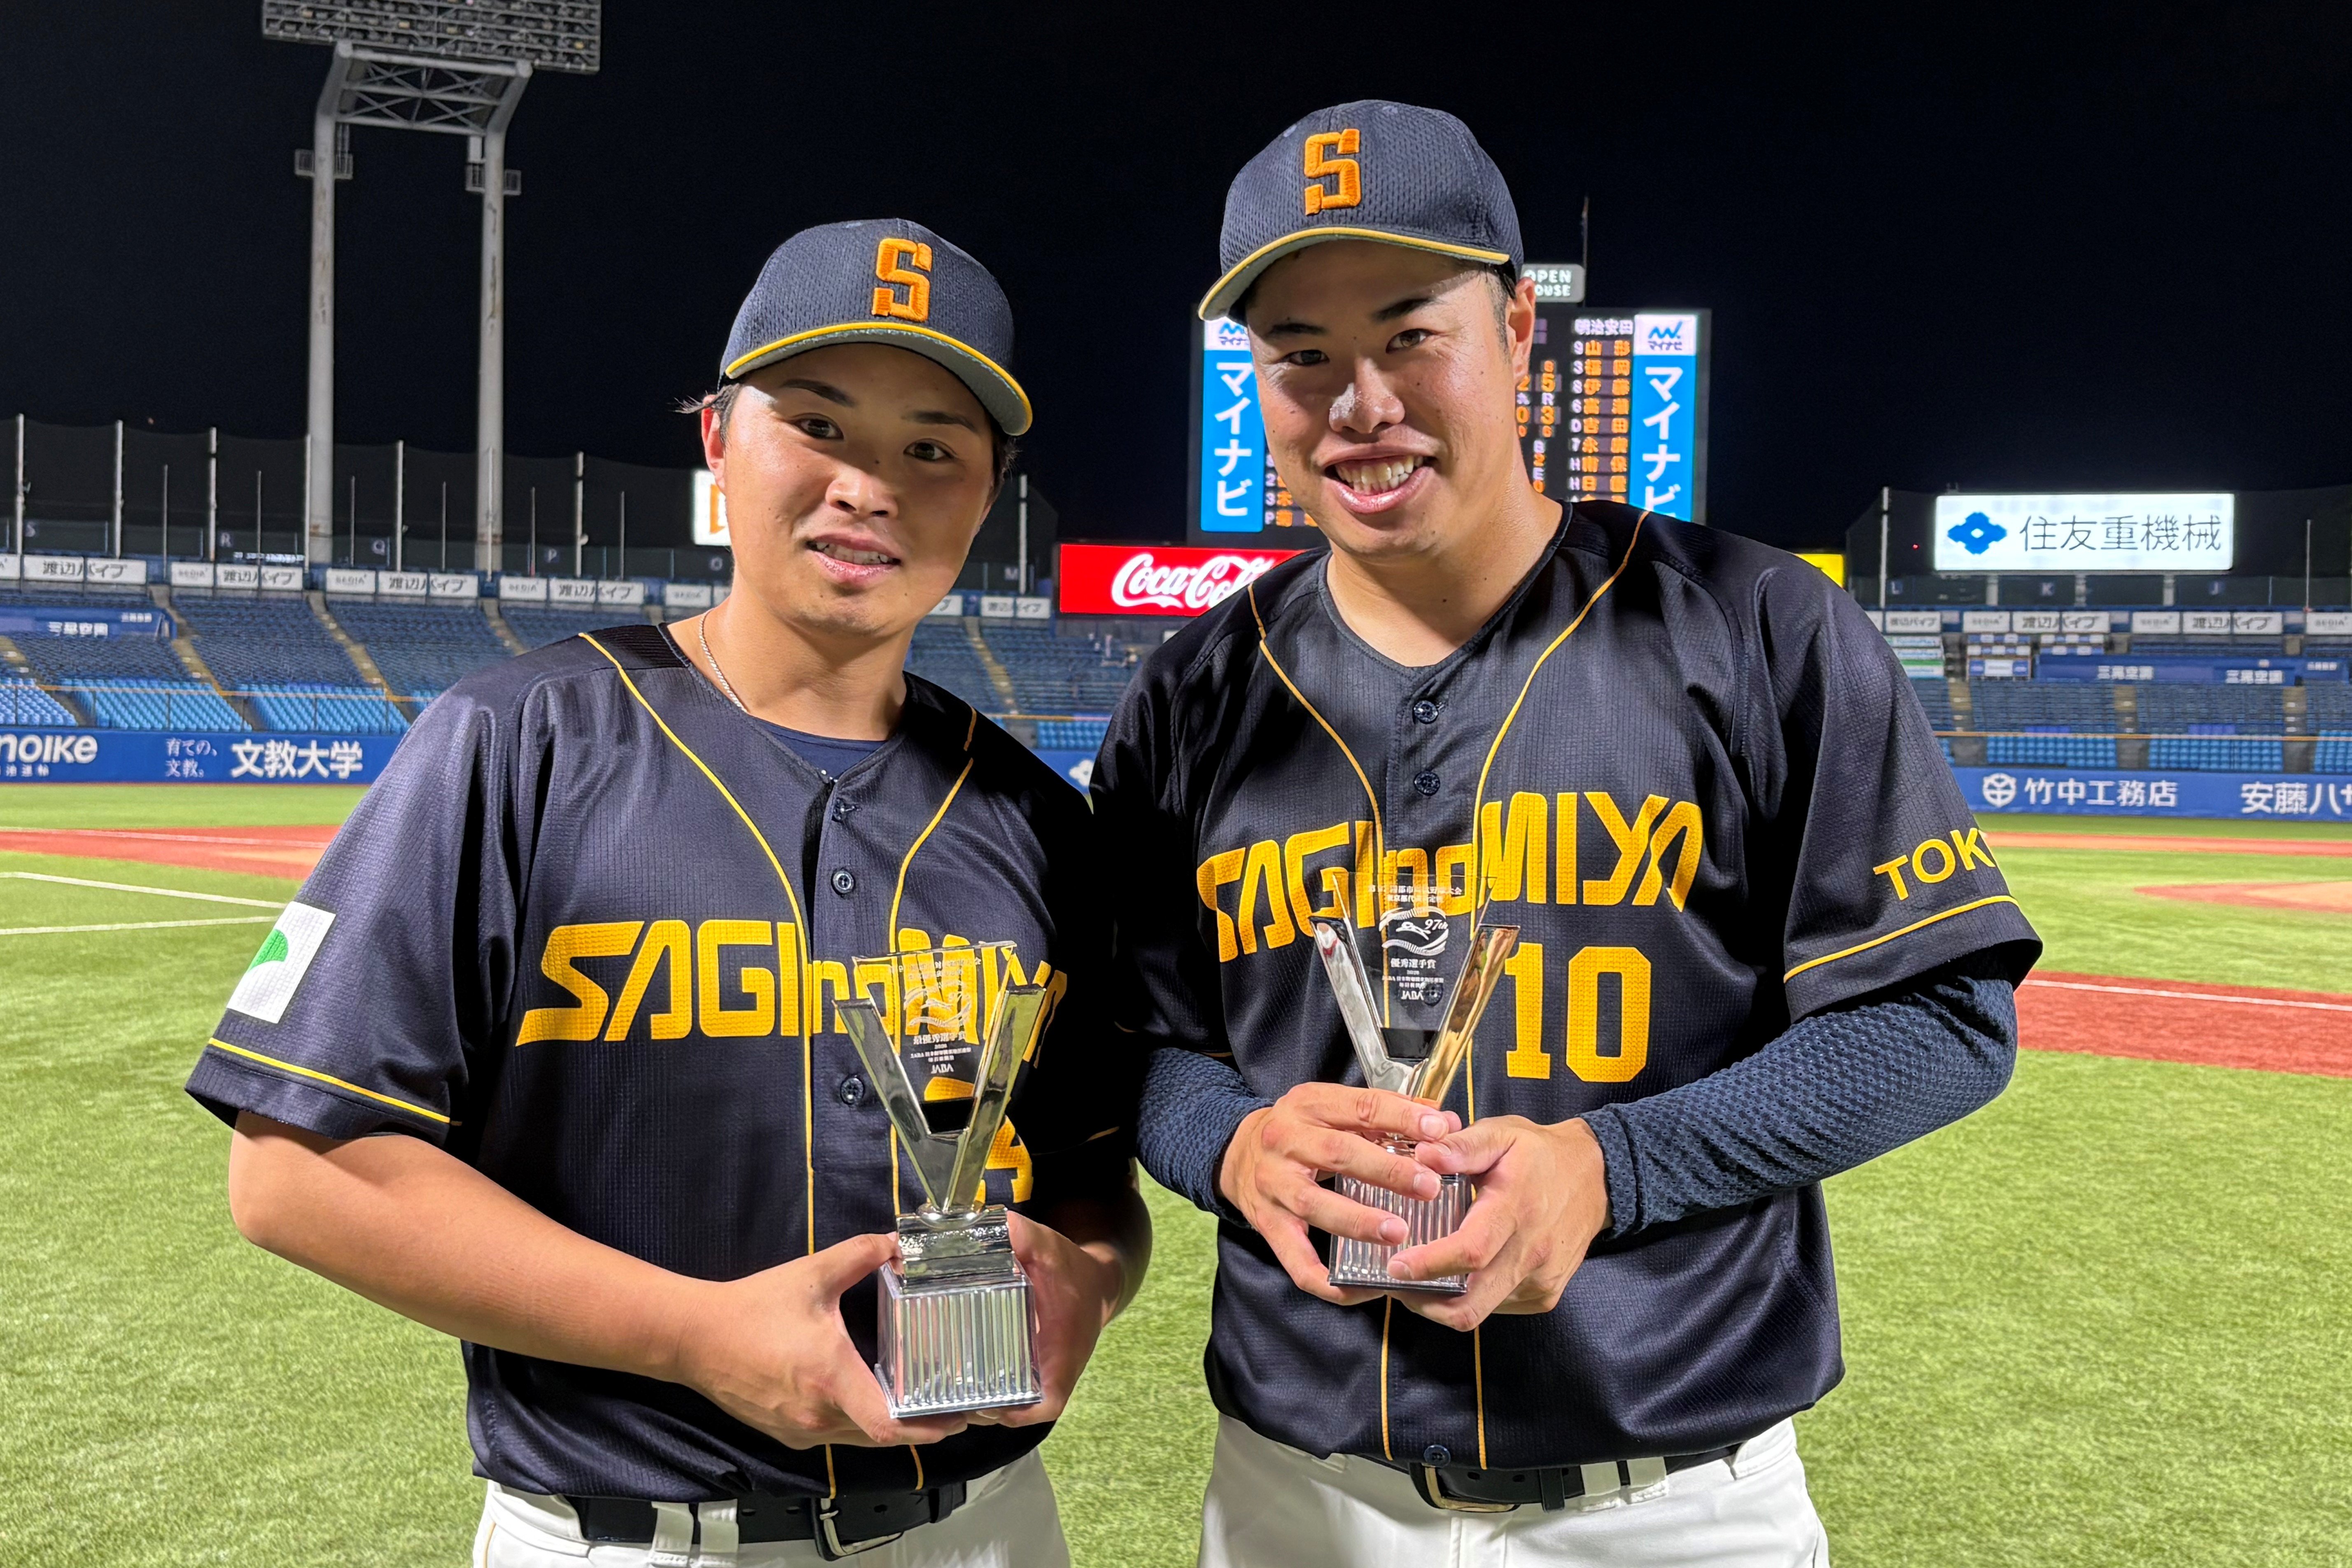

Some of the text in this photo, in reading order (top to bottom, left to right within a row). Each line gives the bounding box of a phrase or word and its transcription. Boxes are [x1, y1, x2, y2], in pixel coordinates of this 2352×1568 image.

[1304, 128, 1361, 215] S
[871, 238, 932, 323] S
[1524, 270, 1571, 283] OPEN
[1534, 284, 1570, 296] OUSE
[1574, 318, 1633, 336] 明治安田
[1219, 336, 1249, 345] マイナ
[1648, 340, 1683, 351] マイナビ
[1541, 373, 1555, 392] 5
[1540, 406, 1554, 425] 3
[1214, 362, 1254, 517] マイナビ
[1642, 366, 1684, 517] マイナビ
[1265, 473, 1276, 487] 2
[1265, 492, 1276, 506] 3
[2019, 515, 2221, 551] 住友重機械
[1111, 553, 1276, 609] Coca-Col
[231, 739, 363, 779] 文教大学
[2025, 777, 2178, 807] 竹中工務店
[1505, 943, 1652, 1083] 10
